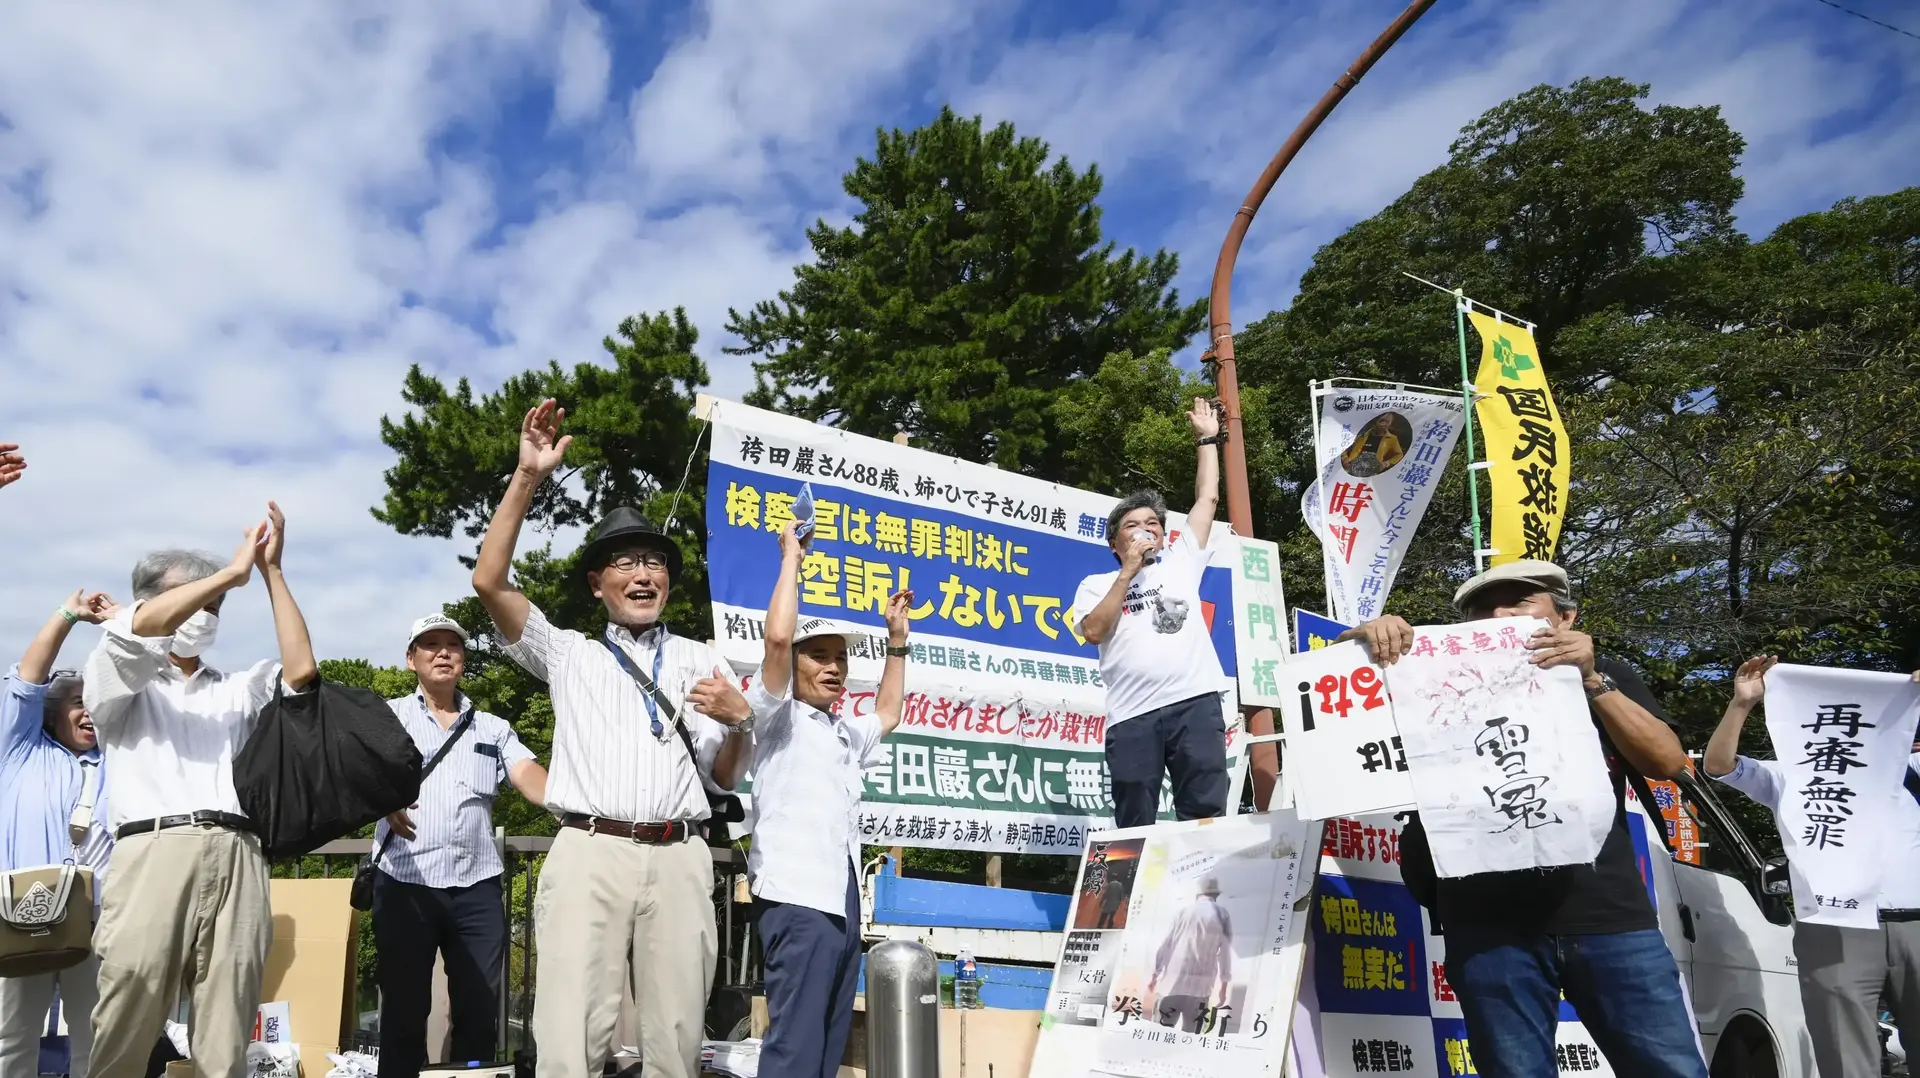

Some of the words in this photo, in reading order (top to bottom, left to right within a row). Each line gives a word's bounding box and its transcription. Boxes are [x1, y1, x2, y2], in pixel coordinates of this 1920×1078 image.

[725, 481, 1030, 576] 検察官は無罪判決に
[1410, 626, 1527, 657] 再審無罪
[1796, 703, 1876, 850] 再審無罪
[1321, 894, 1397, 937] 袴田さんは
[1078, 969, 1107, 984] 反骨
[1352, 1038, 1414, 1073] 検察官は
[1555, 1043, 1600, 1073] 検察官は
